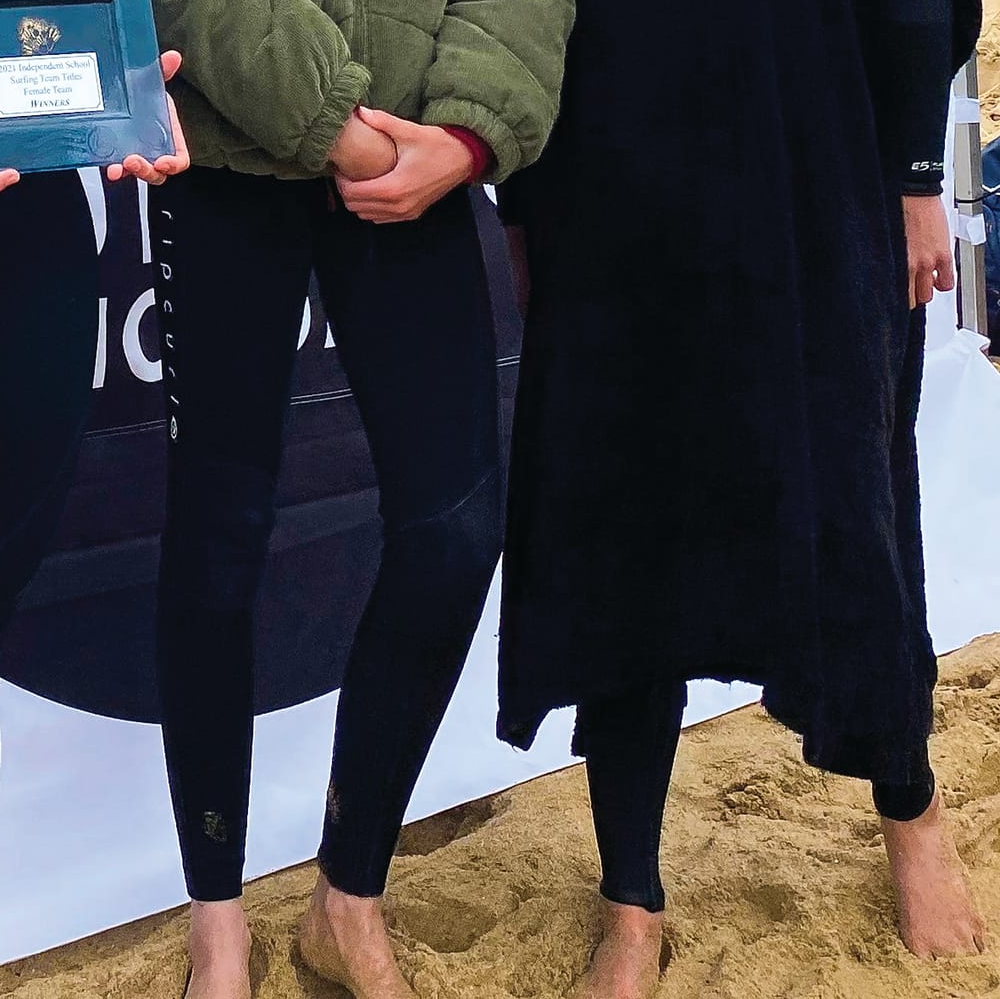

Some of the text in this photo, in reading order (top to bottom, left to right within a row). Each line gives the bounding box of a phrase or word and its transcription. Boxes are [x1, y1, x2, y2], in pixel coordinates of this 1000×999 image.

[18, 61, 64, 73] Independent
[66, 59, 91, 70] School
[10, 72, 83, 85] Surfing Team Titles
[23, 85, 73, 96] Female Team
